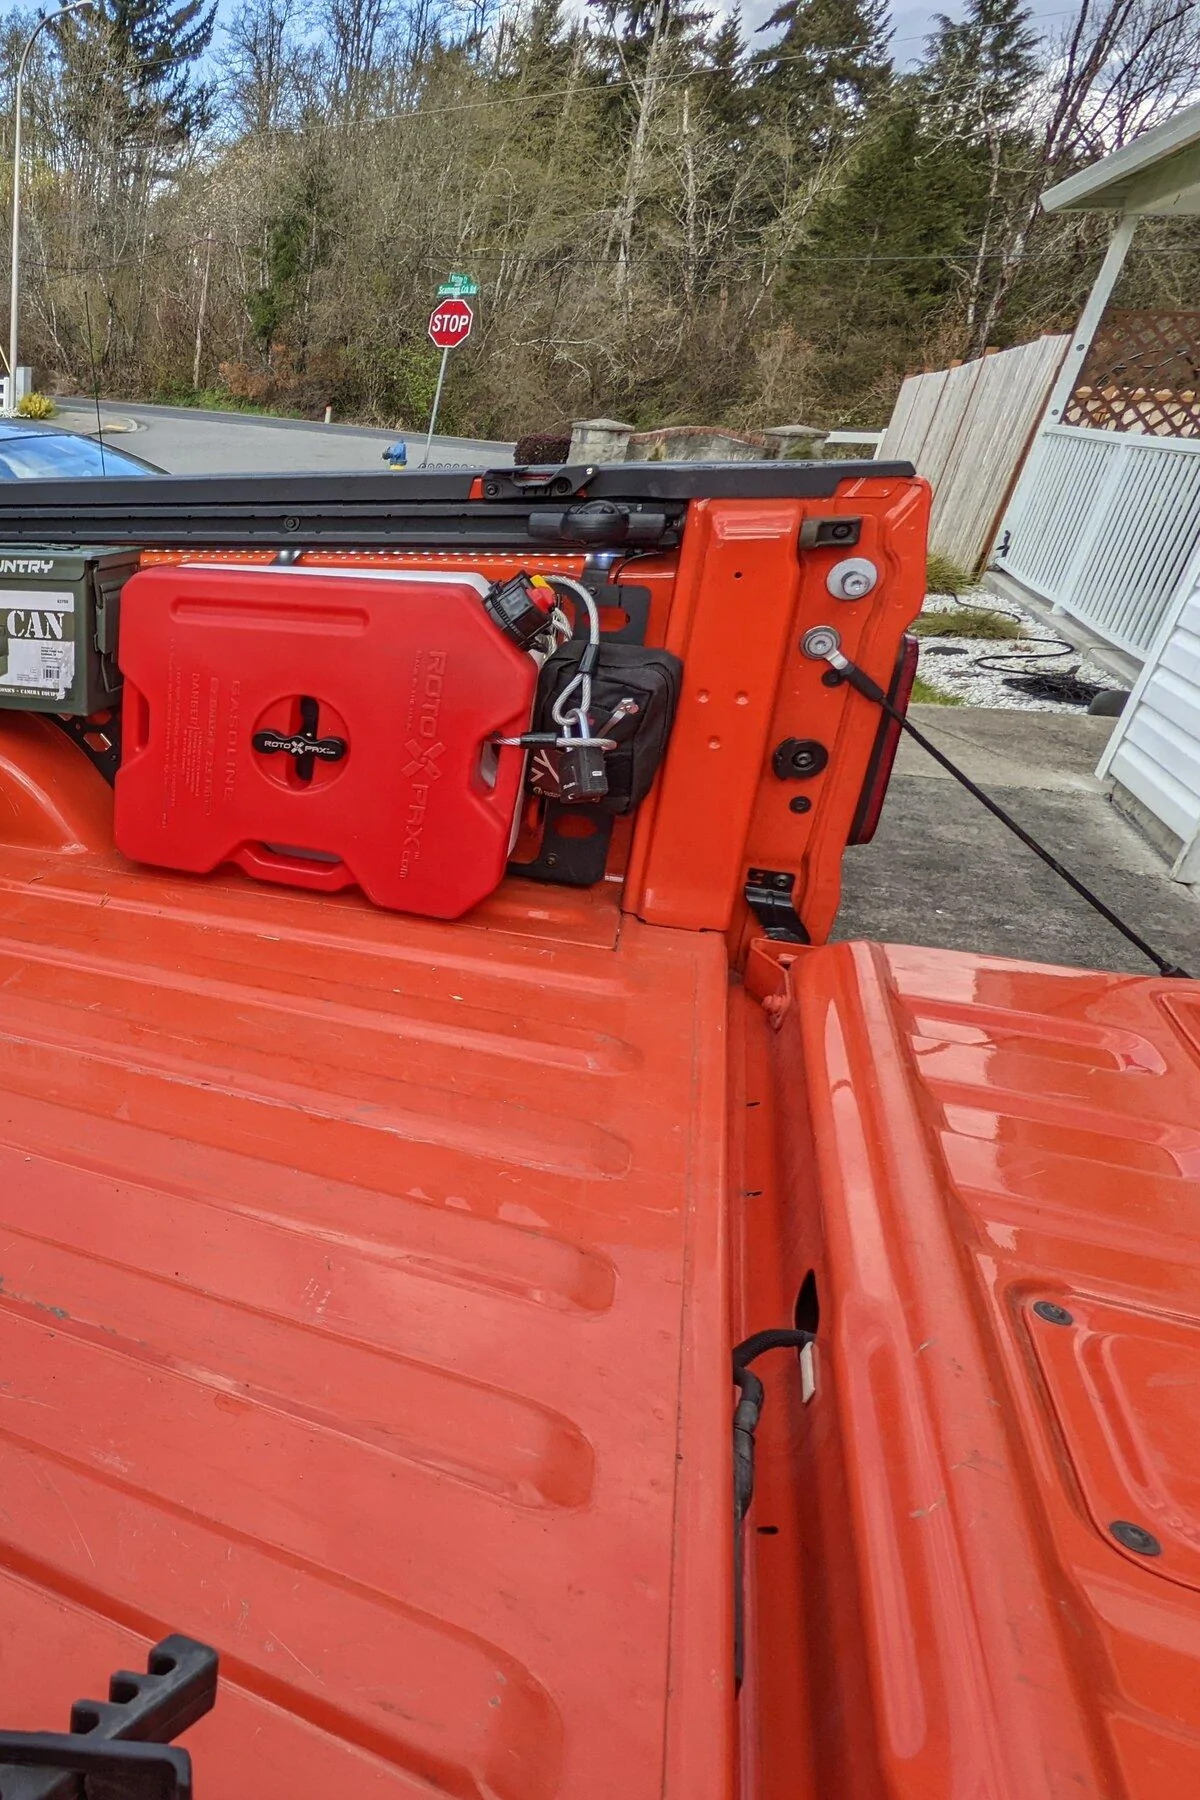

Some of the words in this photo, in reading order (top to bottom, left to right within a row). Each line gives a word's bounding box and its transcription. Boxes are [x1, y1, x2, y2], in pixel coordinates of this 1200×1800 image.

[432, 314, 469, 332] STOP
[6, 609, 65, 640] CAN
[420, 650, 447, 738] ROTO
[264, 740, 291, 749] ROTO
